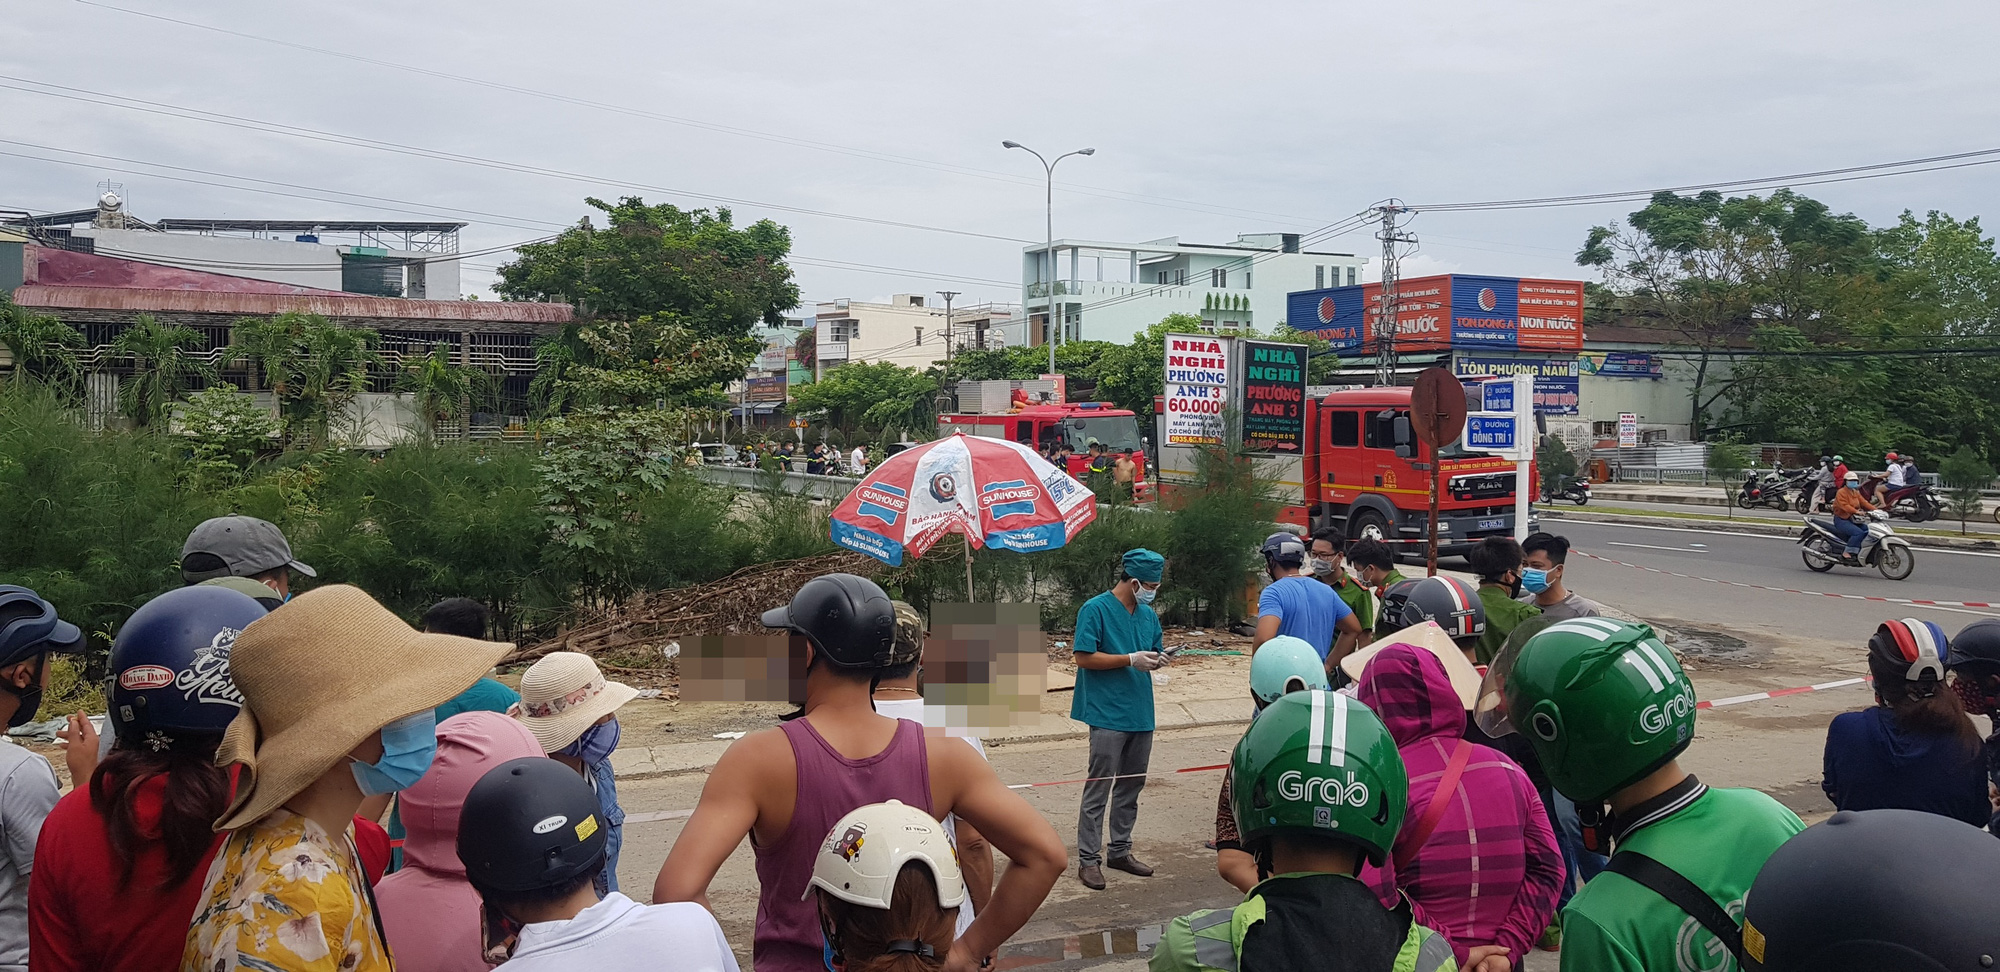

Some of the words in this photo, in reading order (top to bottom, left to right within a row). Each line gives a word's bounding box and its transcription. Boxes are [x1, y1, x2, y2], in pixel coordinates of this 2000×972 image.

[1402, 314, 1440, 334] NƯỚC
[1520, 316, 1544, 329] NON
[1547, 314, 1576, 330] NƯỚC
[1172, 339, 1222, 354] NHÀ
[1169, 354, 1225, 369] NGHỈ
[1253, 347, 1298, 364] NHÀ
[1168, 368, 1226, 384] PHƯƠNG
[1248, 365, 1300, 382] NGHỈ
[1461, 361, 1486, 374] TÔN
[1489, 362, 1539, 376] PHƯƠNG
[1542, 365, 1568, 376] NAM
[1176, 385, 1208, 398] ANH
[1212, 387, 1221, 399] 3
[1247, 384, 1301, 402] PHƯƠNG
[1251, 403, 1284, 416] ANH
[1289, 404, 1298, 417] 3
[1485, 419, 1510, 428] ĐƯỜNG
[1494, 431, 1506, 443] TRÍ
[1508, 433, 1512, 443] 1
[1477, 481, 1502, 490] MAN
[862, 490, 905, 509] SUNHOUSE
[982, 489, 1034, 504] SUNHOUSE
[912, 514, 930, 525] BẢO
[213, 649, 230, 657] AN
[123, 674, 145, 684] HOÀNG
[147, 672, 170, 682] DANH
[1640, 679, 1694, 734] Grab
[1277, 770, 1369, 808] Grab
